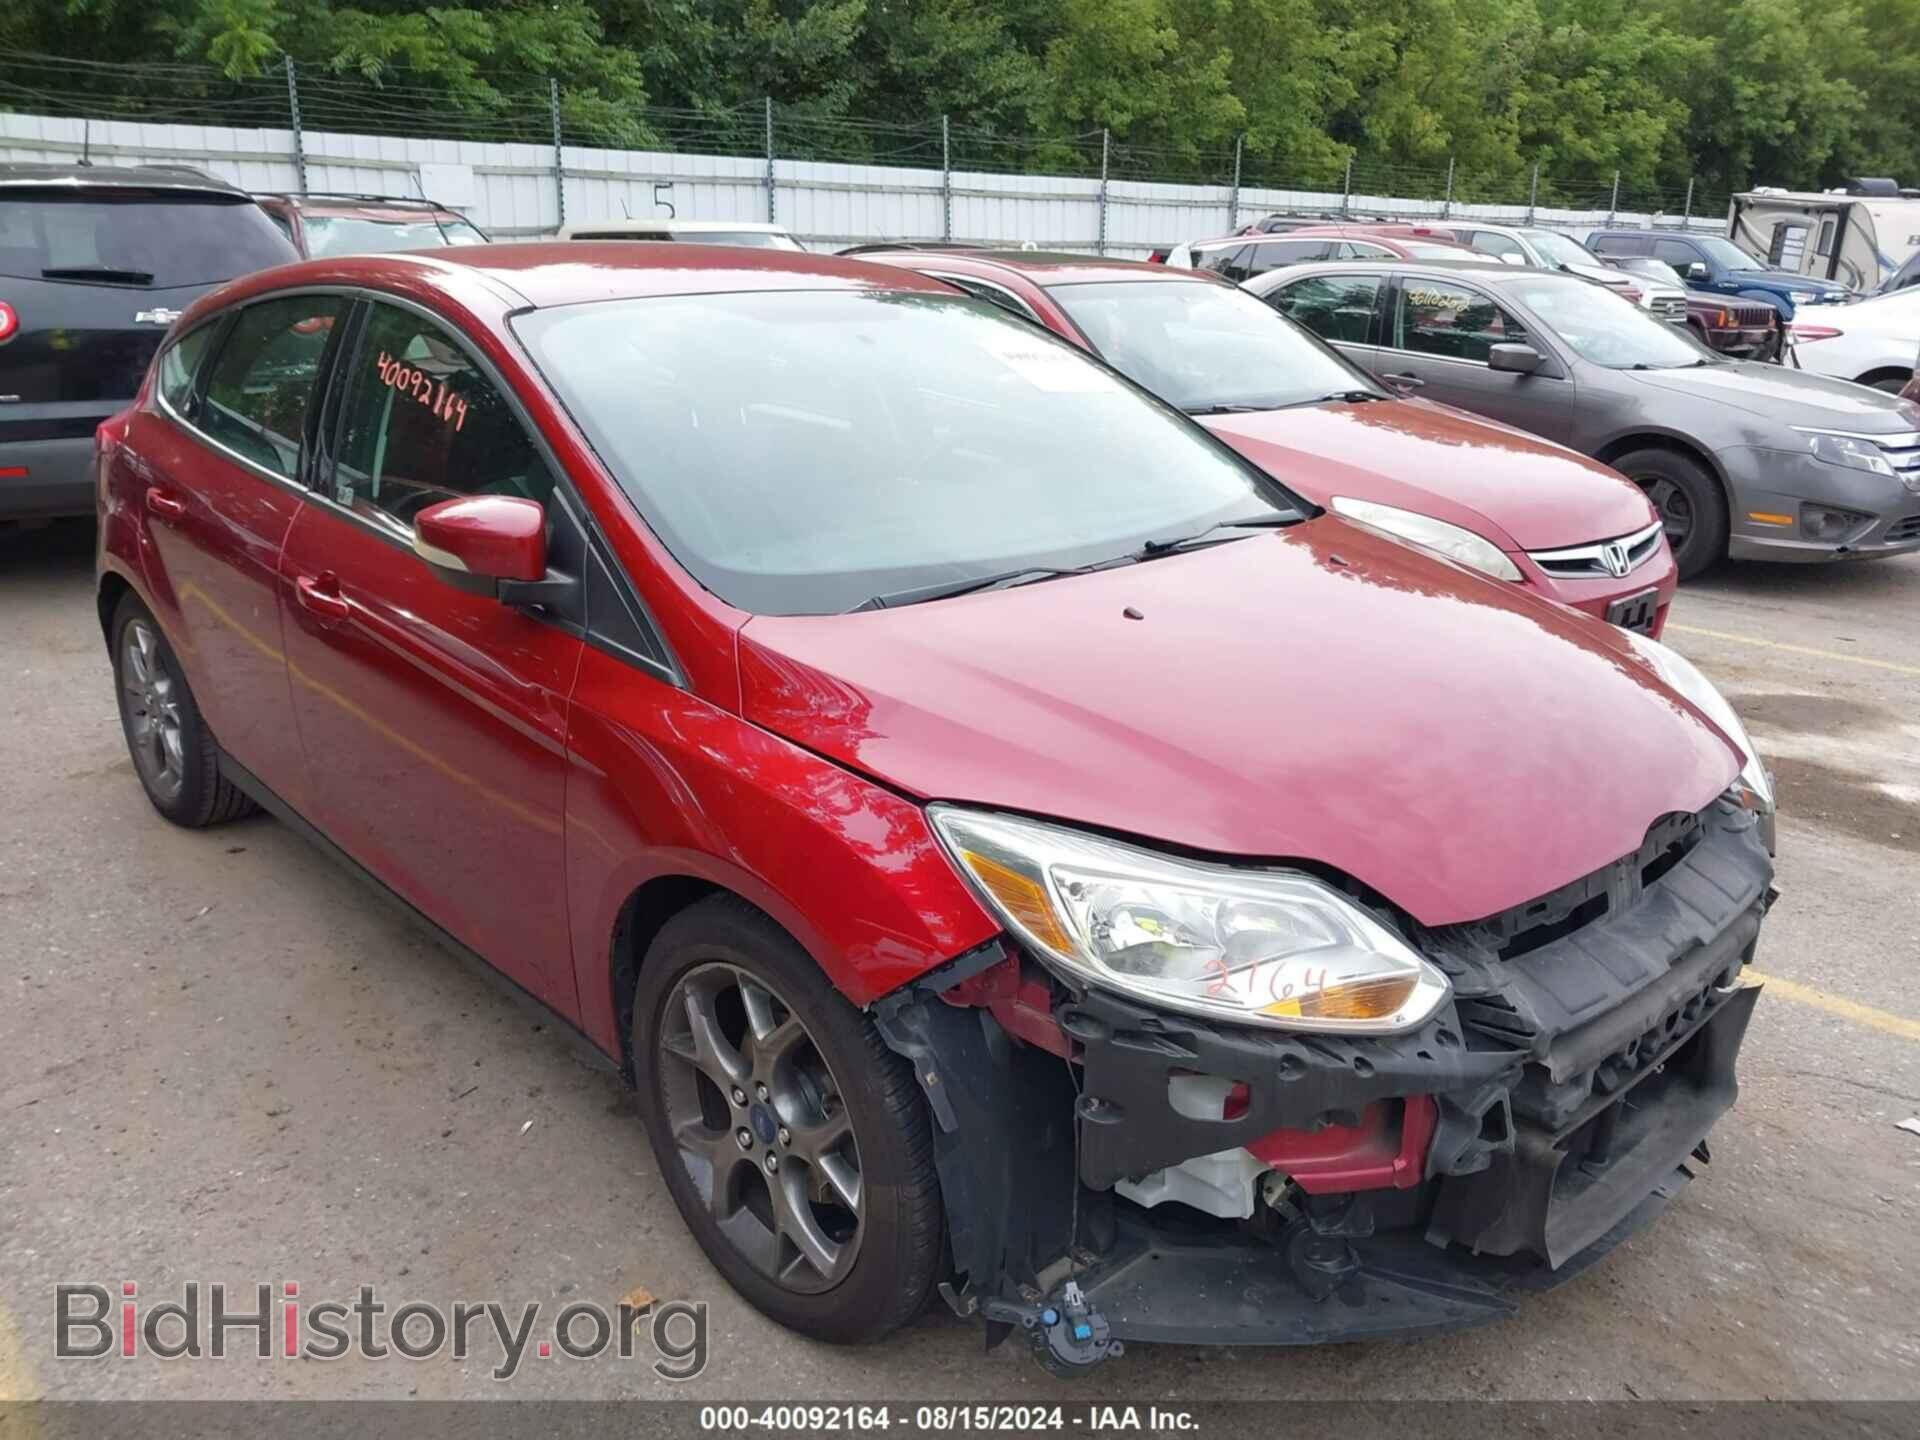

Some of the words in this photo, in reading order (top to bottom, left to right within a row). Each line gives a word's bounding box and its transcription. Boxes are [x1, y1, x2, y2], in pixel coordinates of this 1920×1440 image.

[654, 181, 675, 219] 5
[377, 351, 467, 432] 40092164
[1203, 958, 1328, 1001] 2164
